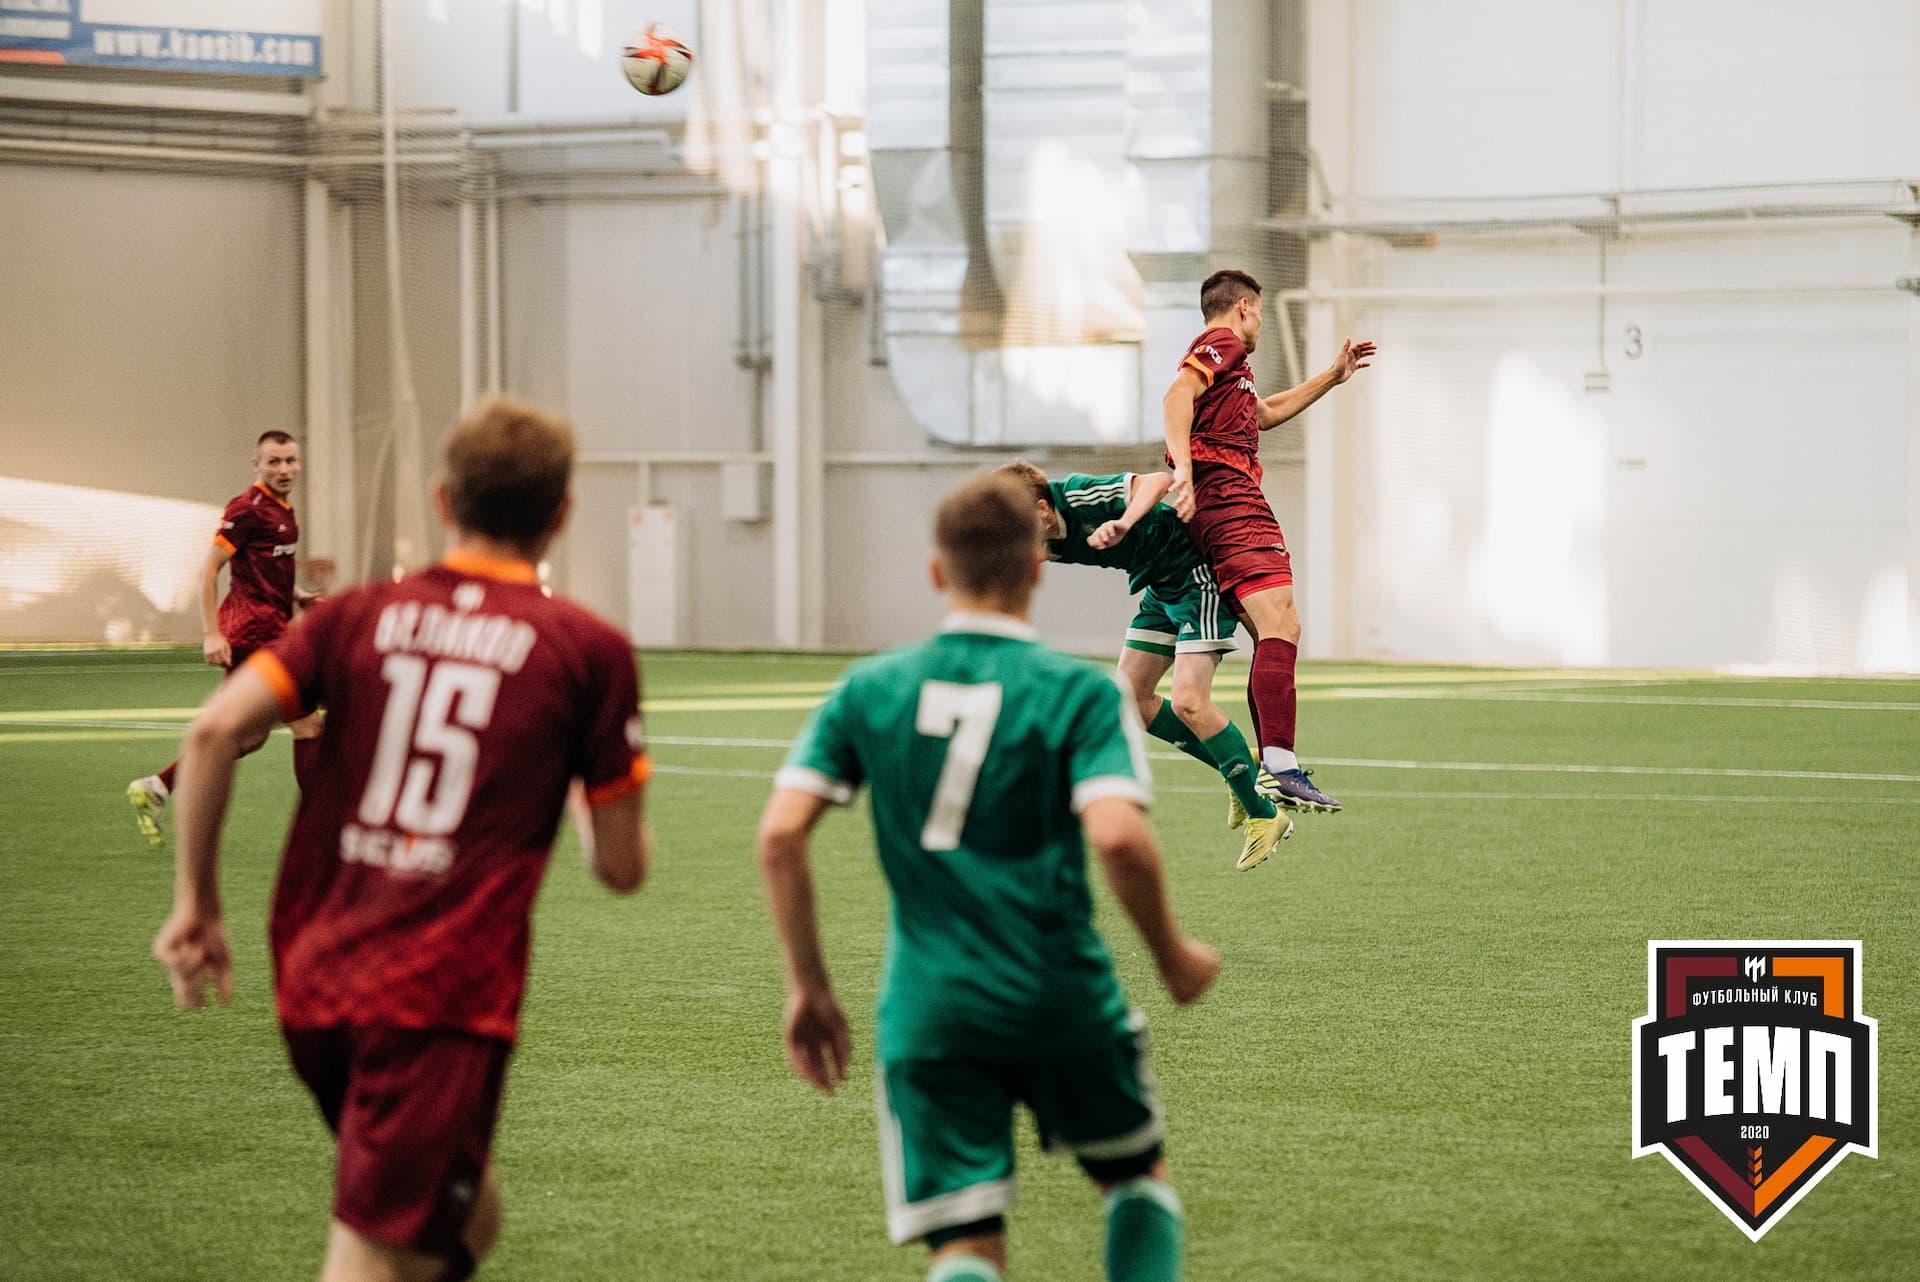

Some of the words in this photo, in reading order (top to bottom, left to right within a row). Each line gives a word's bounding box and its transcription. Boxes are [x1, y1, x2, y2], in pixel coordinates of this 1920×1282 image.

[1623, 323, 1643, 361] 3
[358, 653, 502, 834] 15
[915, 679, 1003, 851] 7
